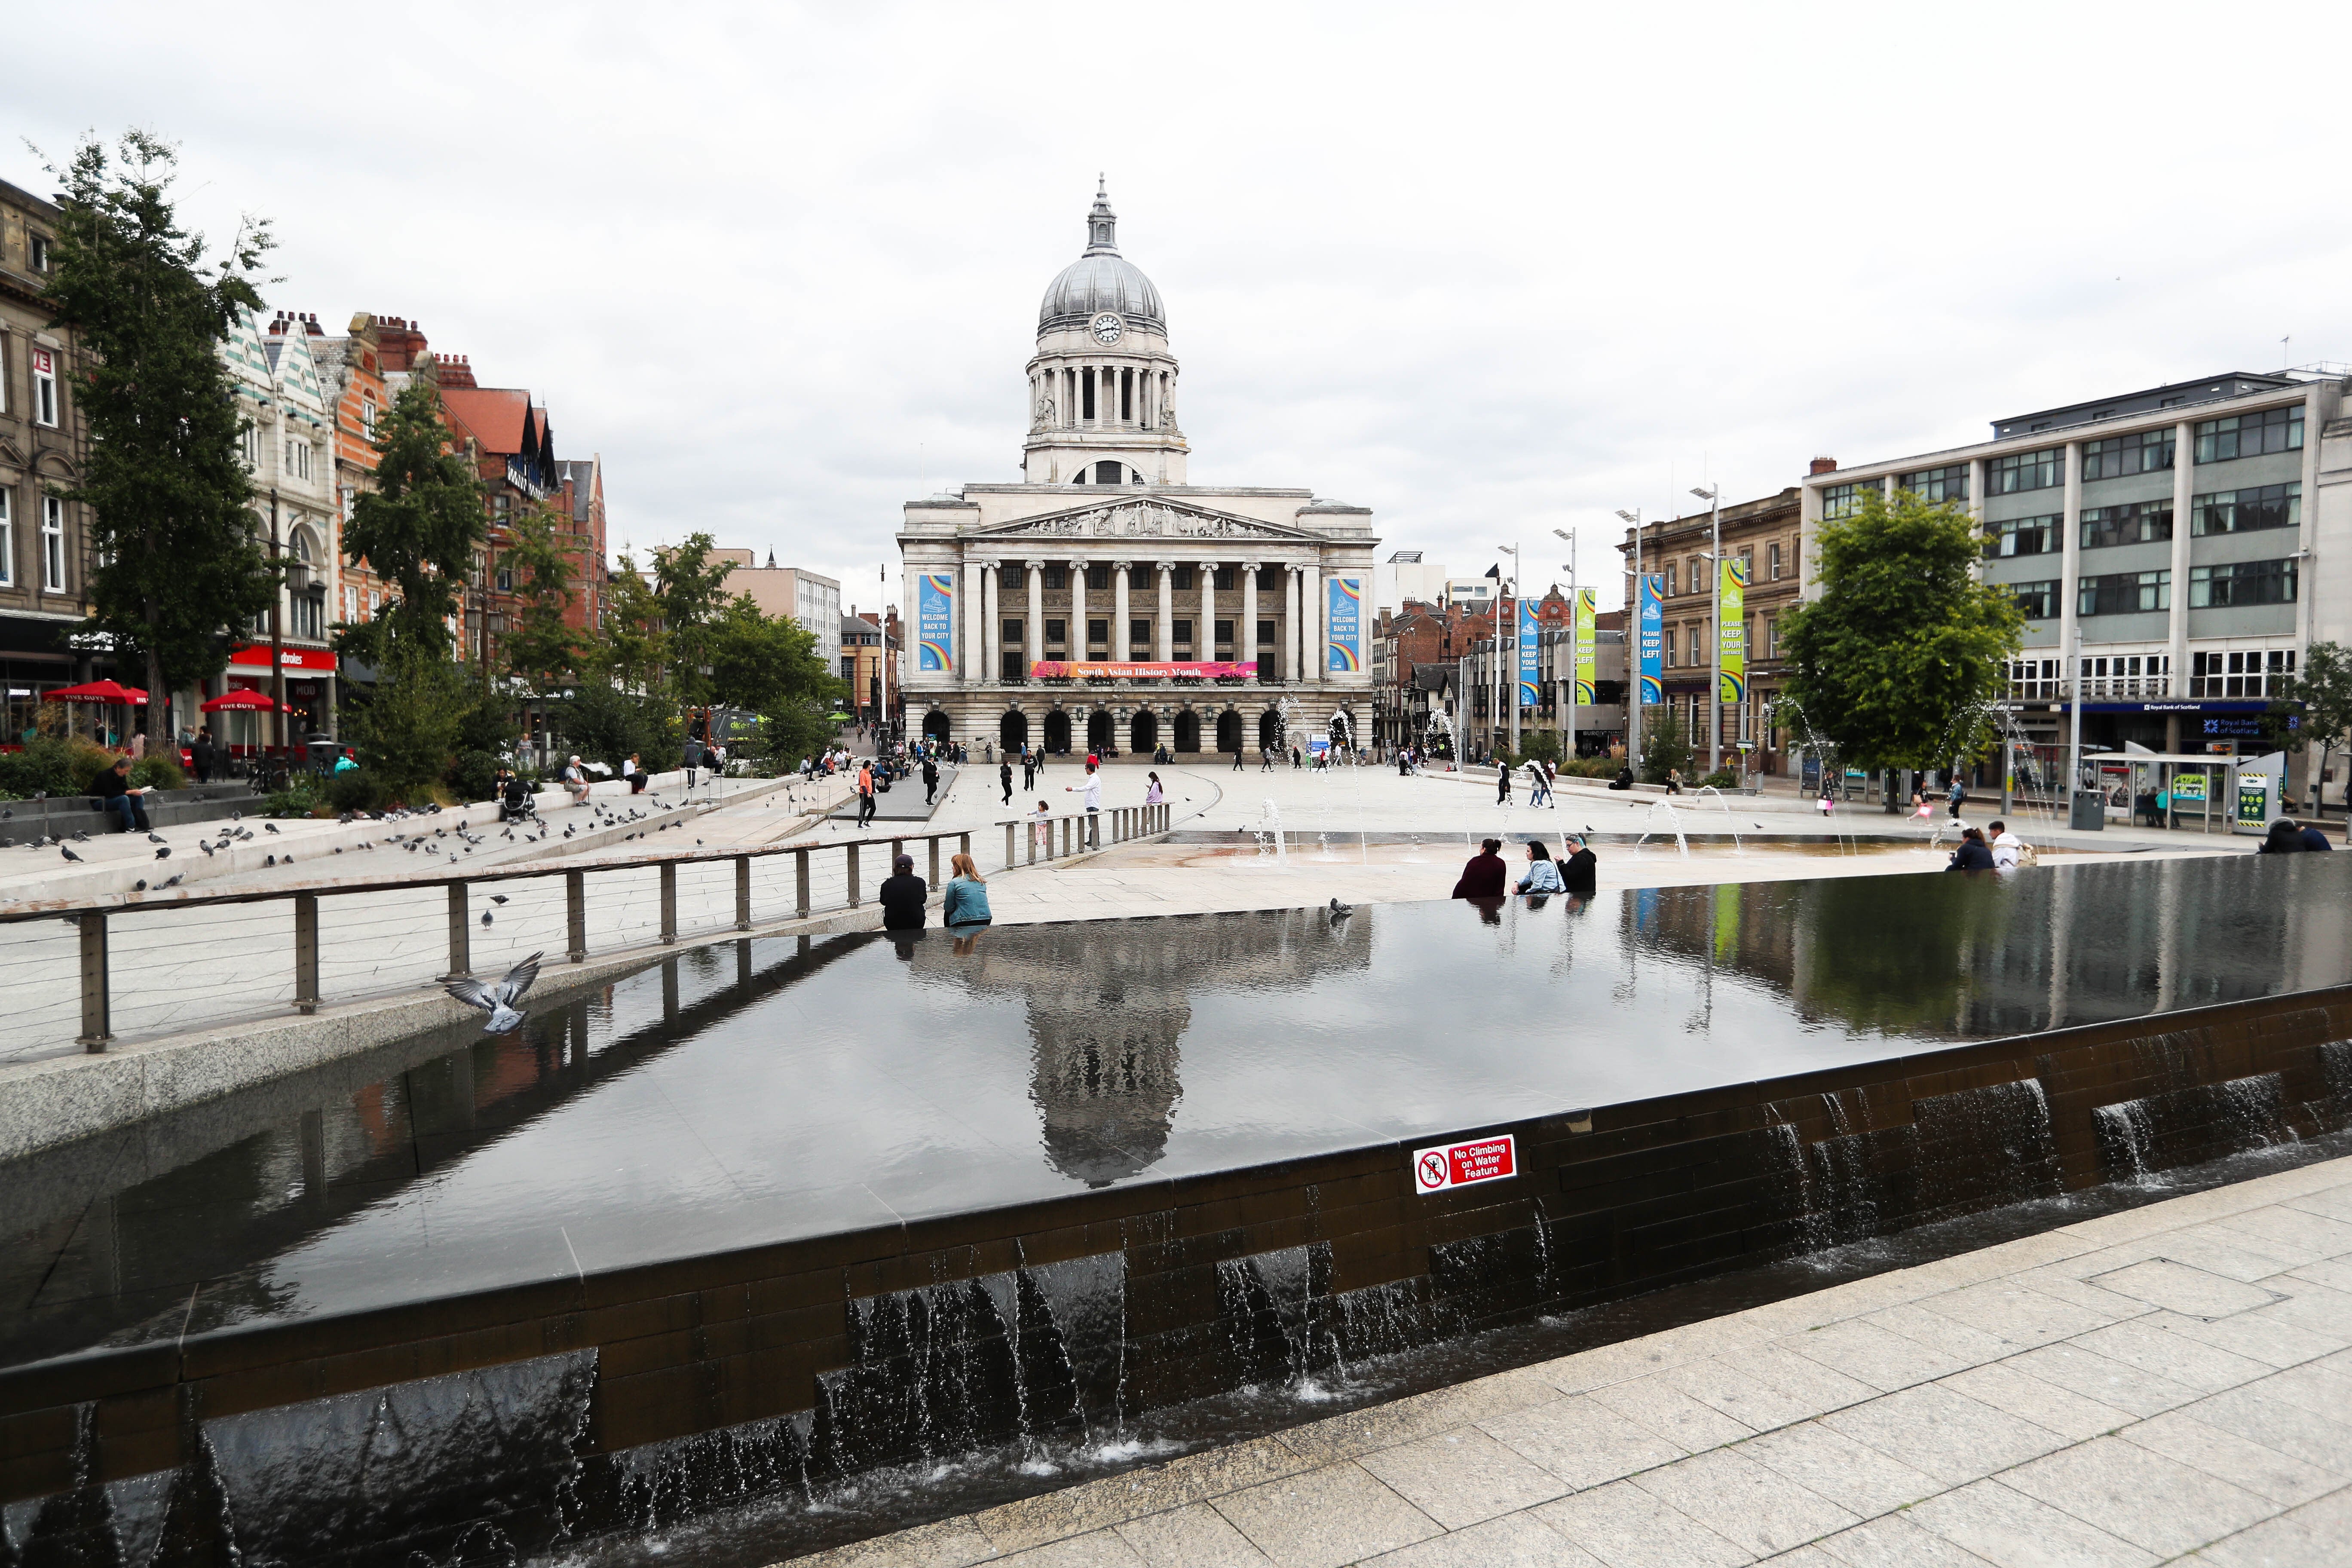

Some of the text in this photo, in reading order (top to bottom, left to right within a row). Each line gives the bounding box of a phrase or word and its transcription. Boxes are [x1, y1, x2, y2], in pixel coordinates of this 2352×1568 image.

[281, 652, 303, 665] dbrokes
[1135, 668, 1168, 677] History
[296, 685, 315, 695] MOD
[1454, 1143, 1506, 1160] No Climbing
[1461, 1155, 1500, 1169] on Water
[1465, 1166, 1498, 1179] Feature
